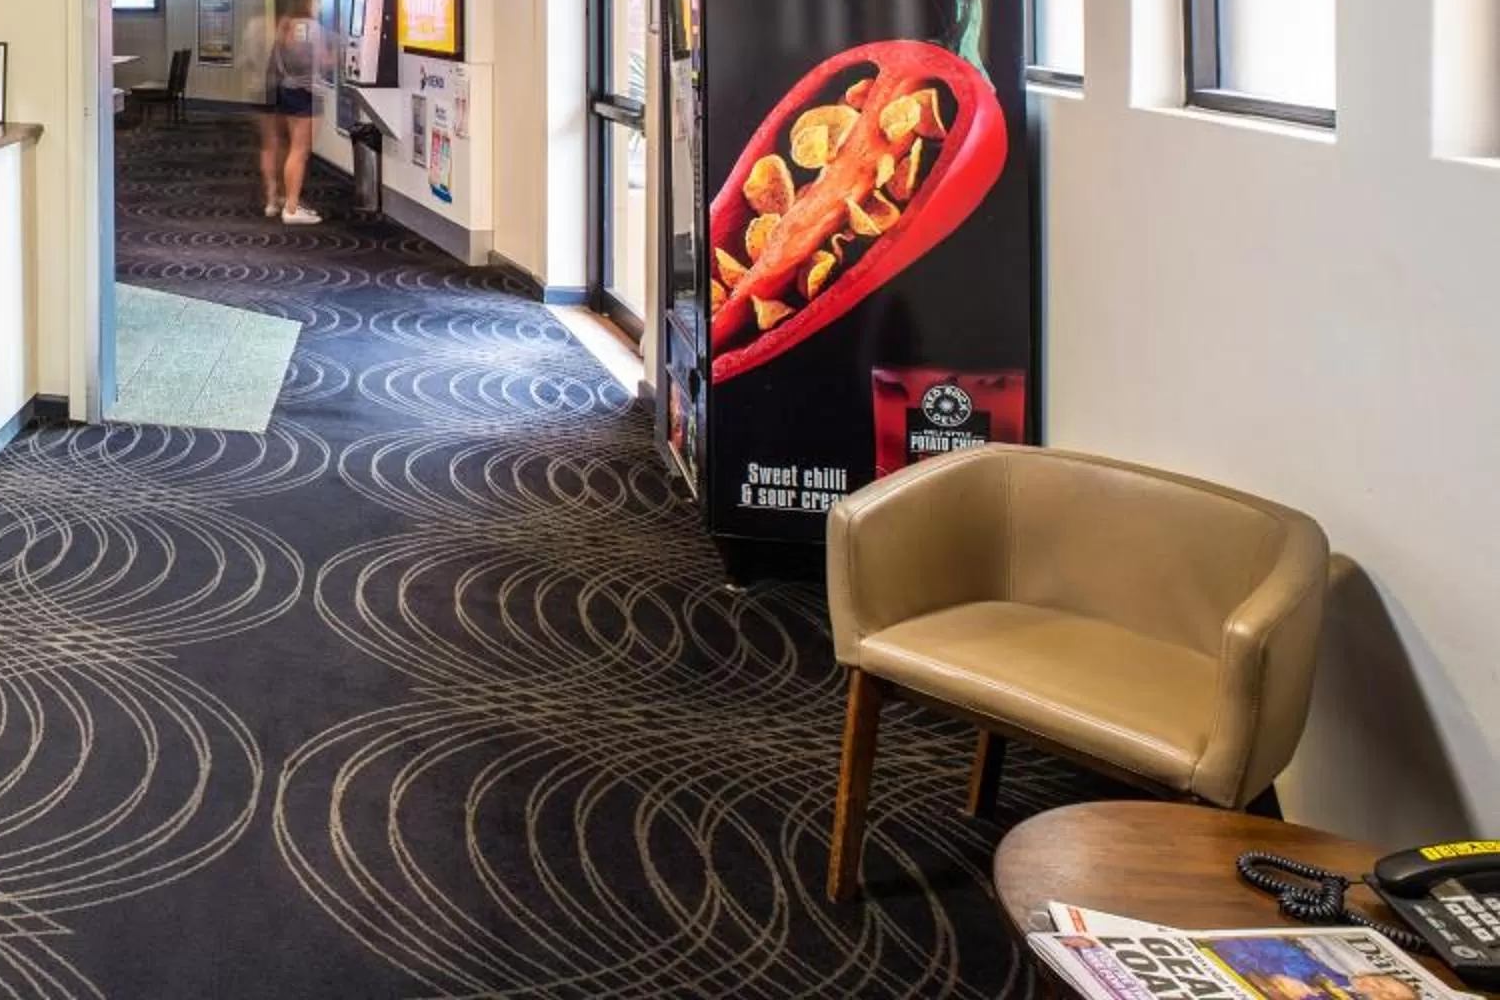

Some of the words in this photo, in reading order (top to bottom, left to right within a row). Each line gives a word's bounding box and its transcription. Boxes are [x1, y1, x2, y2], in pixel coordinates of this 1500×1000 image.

[911, 436, 949, 451] POTATO
[748, 462, 798, 487] Sweet
[803, 467, 848, 491] chilli
[741, 483, 752, 505] &
[757, 487, 797, 507] sour
